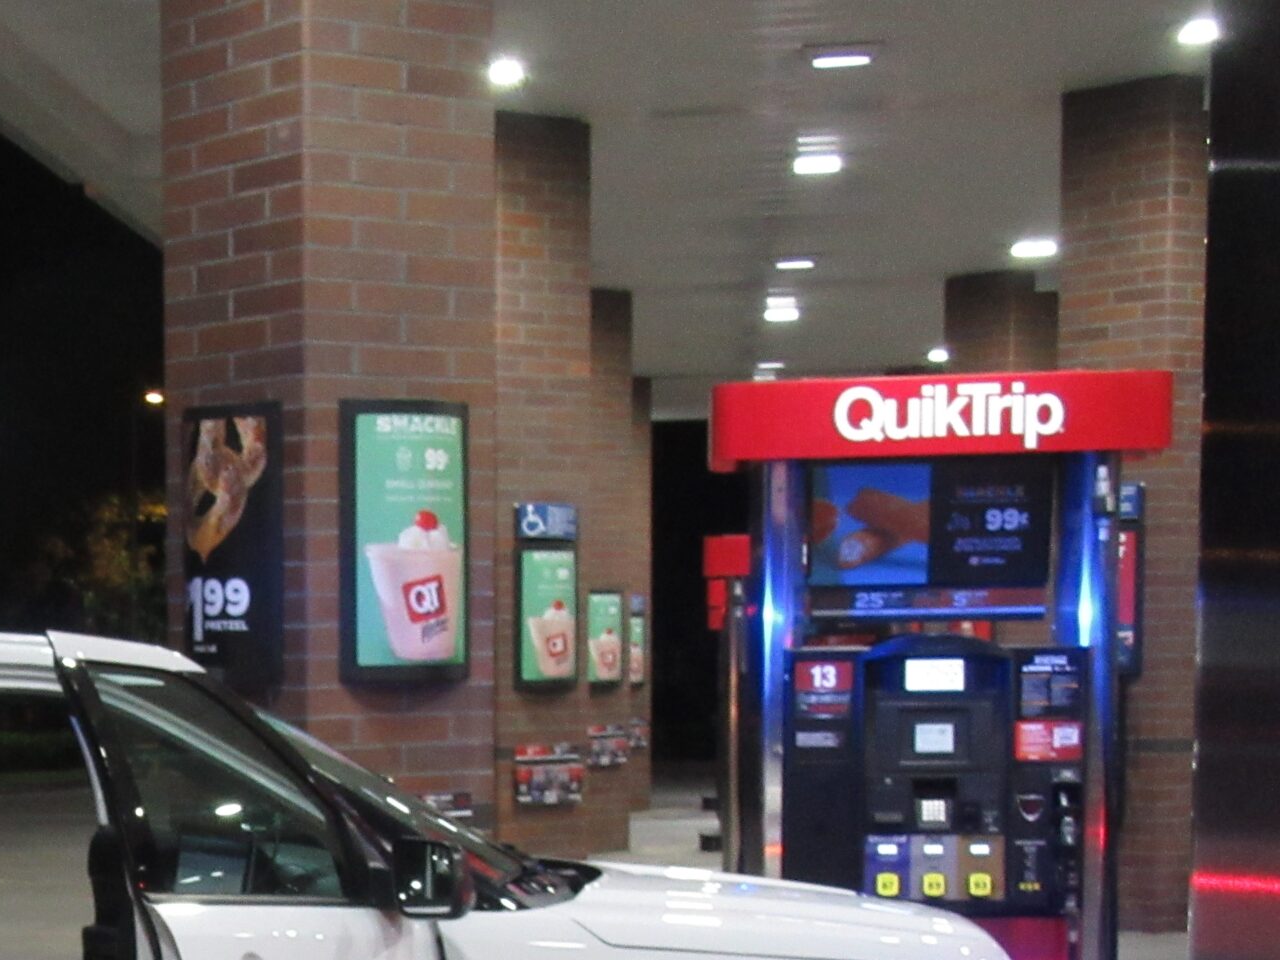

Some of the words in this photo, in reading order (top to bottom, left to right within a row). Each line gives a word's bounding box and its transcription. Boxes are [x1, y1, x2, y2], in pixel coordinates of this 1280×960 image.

[834, 381, 1064, 449] QuikTrip
[409, 581, 440, 613] QT
[811, 664, 837, 688] 13
